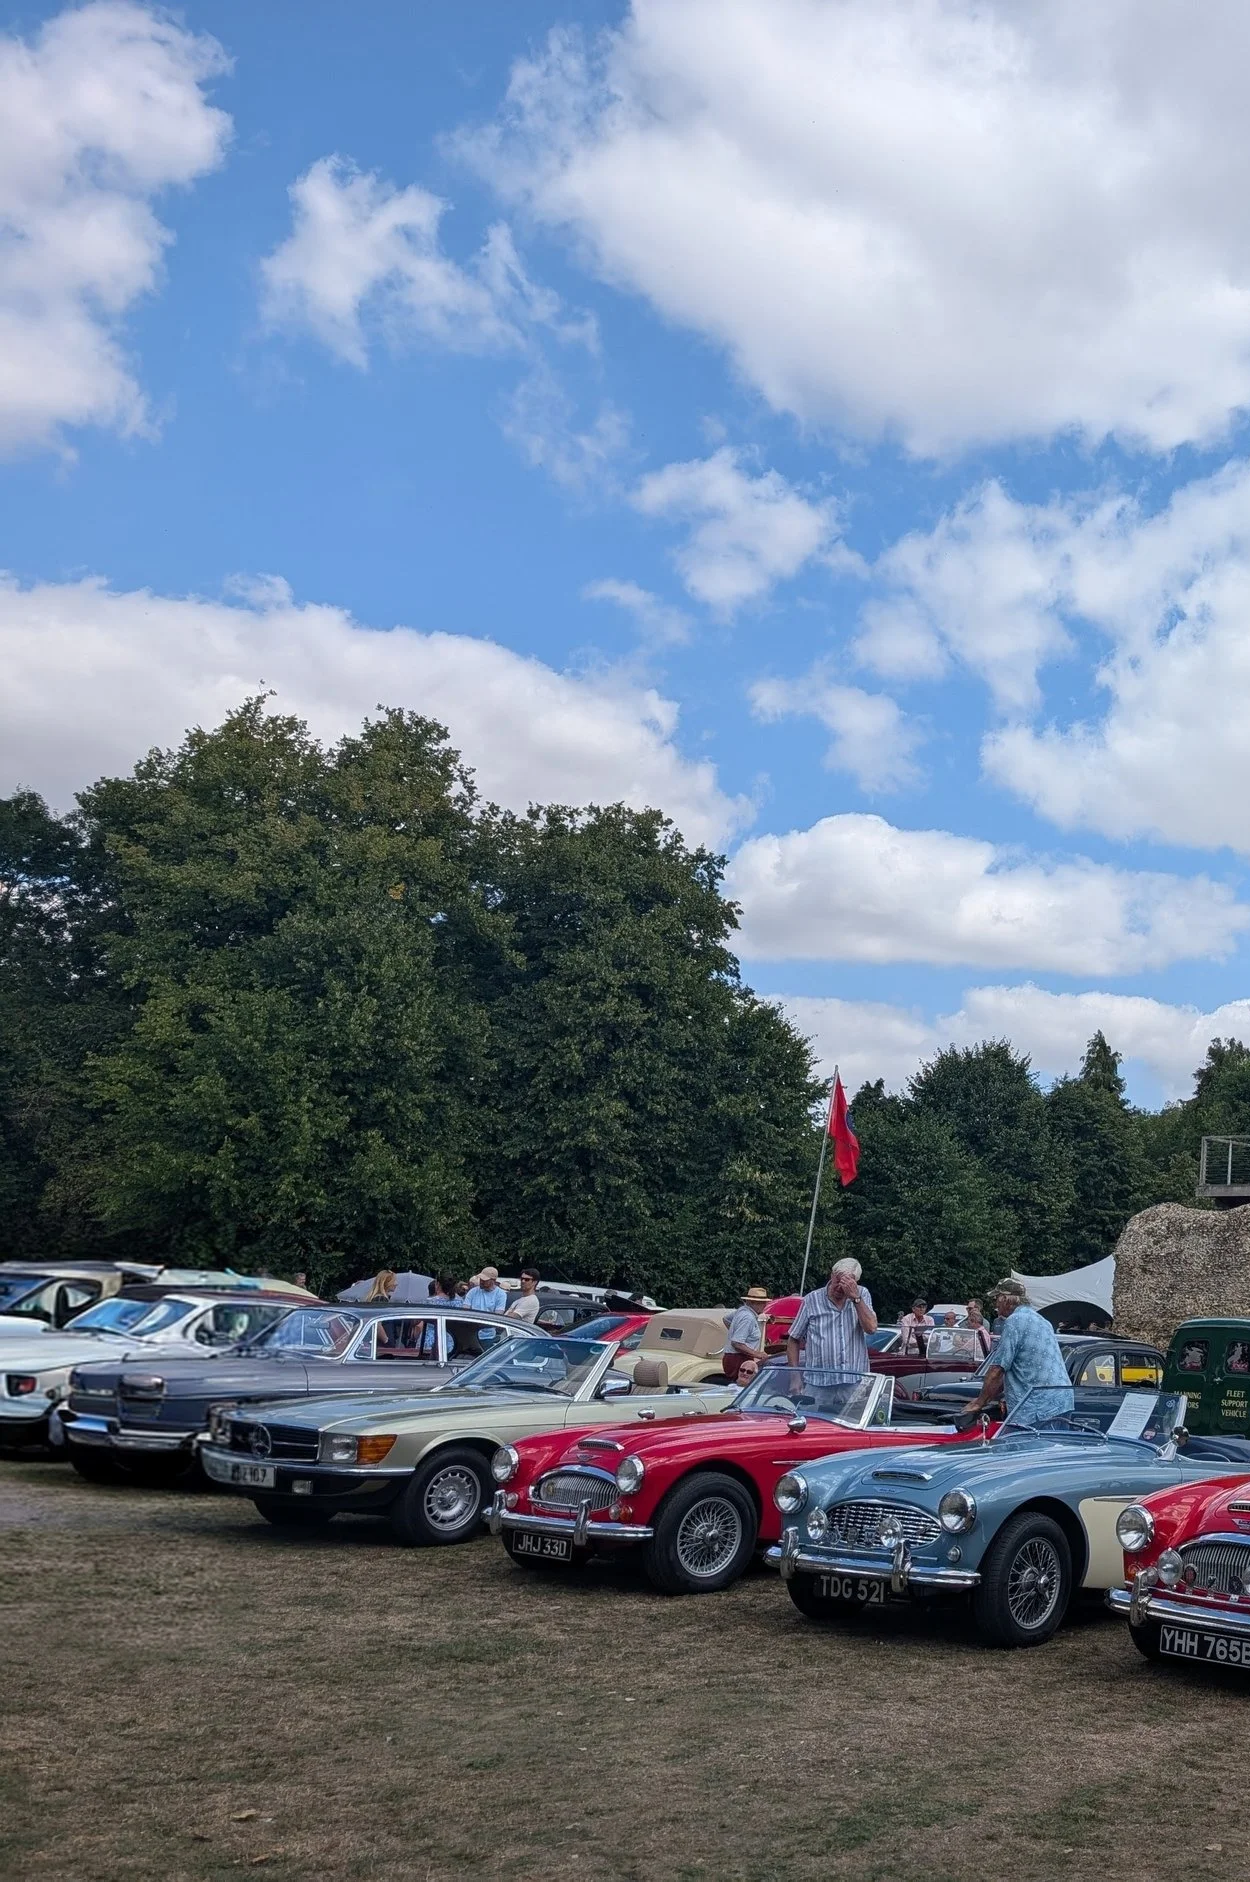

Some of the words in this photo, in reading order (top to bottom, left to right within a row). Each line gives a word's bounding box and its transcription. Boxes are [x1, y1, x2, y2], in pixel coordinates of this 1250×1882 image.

[1226, 1389, 1246, 1398] FLEET
[1220, 1399, 1249, 1408] SUPPORT
[1221, 1409, 1247, 1418] VEHICLE
[518, 1534, 542, 1553] JHJ
[542, 1537, 567, 1557] 33D
[820, 1574, 853, 1599] TDG
[857, 1579, 885, 1603] 521
[1163, 1628, 1199, 1655] YHH
